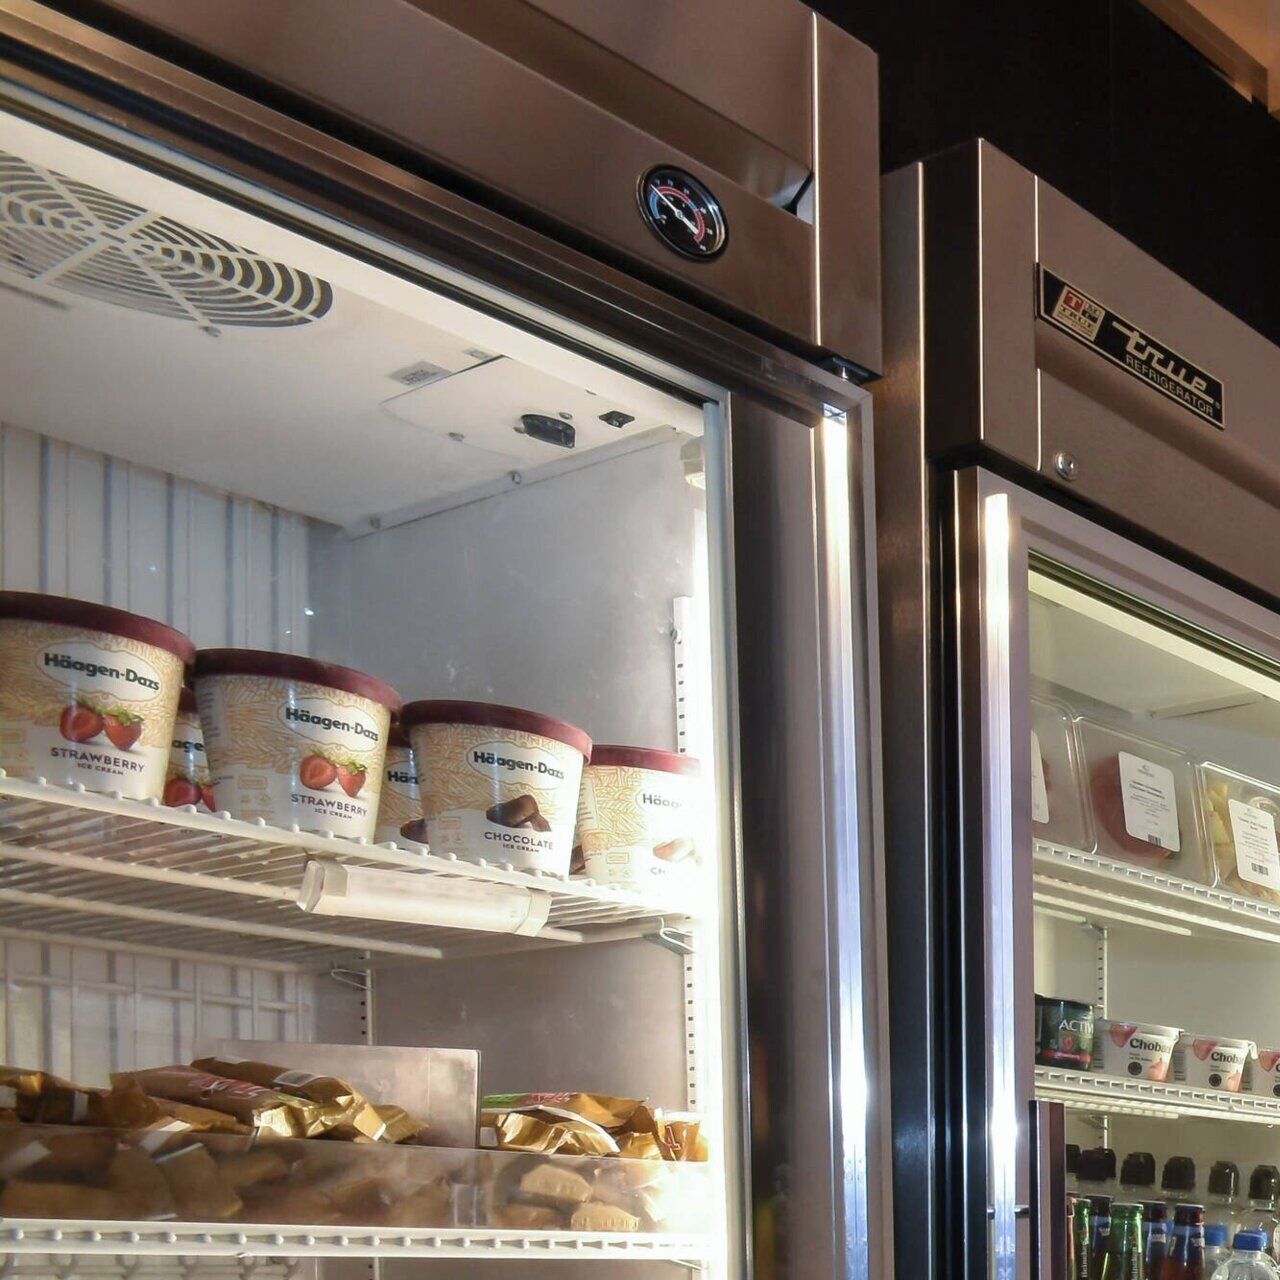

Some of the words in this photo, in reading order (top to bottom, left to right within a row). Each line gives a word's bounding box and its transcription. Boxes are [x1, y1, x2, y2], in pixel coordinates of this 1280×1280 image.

[1111, 320, 1214, 404] true
[1125, 354, 1213, 416] REFRIGERATOR
[44, 652, 160, 691] Häagen-Dazs
[285, 707, 379, 742] Häagen-Dazs
[51, 747, 145, 772] STRAWBERRY
[95, 765, 124, 776] CREAM
[473, 751, 565, 780] Häagen-Dazs
[291, 794, 368, 816] STRAWBERRY
[484, 831, 554, 850] CHOCOLATE
